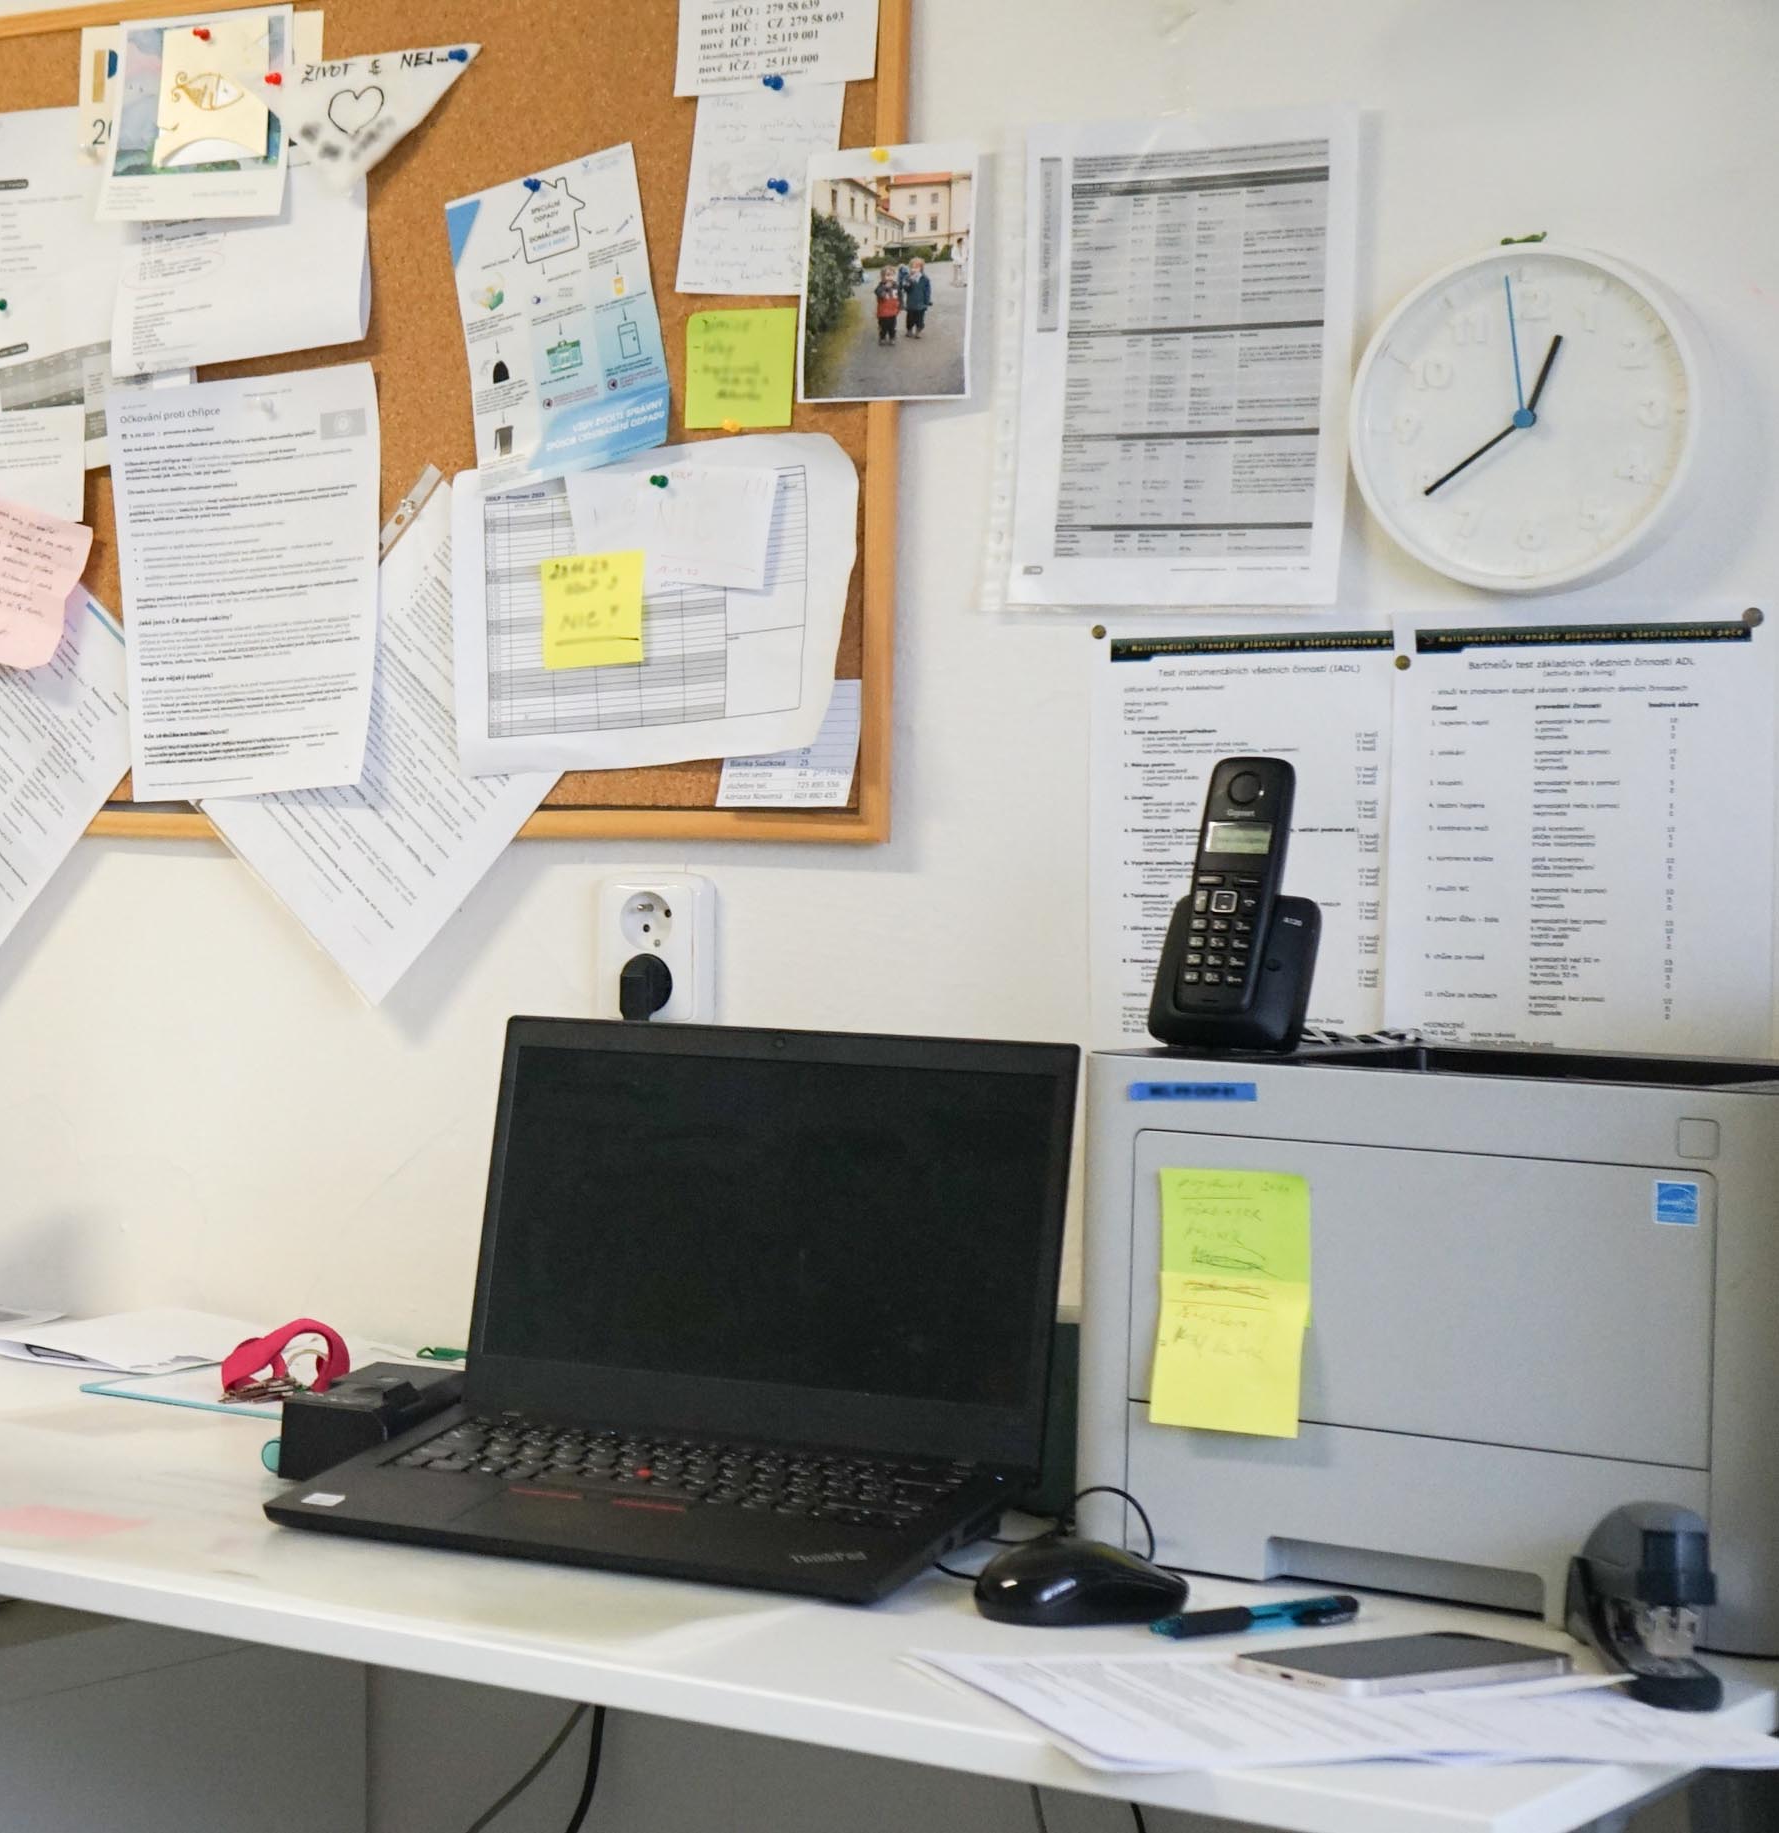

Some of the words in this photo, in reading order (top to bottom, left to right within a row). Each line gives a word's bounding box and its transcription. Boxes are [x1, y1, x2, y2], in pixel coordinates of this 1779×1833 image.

[119, 410, 162, 425] Očkování
[163, 408, 186, 422] proti
[187, 406, 221, 420] chřipce
[1469, 659, 1513, 670] Barthelův
[1516, 659, 1534, 669] test
[1537, 657, 1586, 669] základních
[1590, 656, 1631, 668] všedních
[1675, 656, 1695, 666] ADL
[1158, 668, 1175, 677] Test
[1178, 665, 1249, 677] instrumentálních
[1252, 664, 1289, 675] všedních
